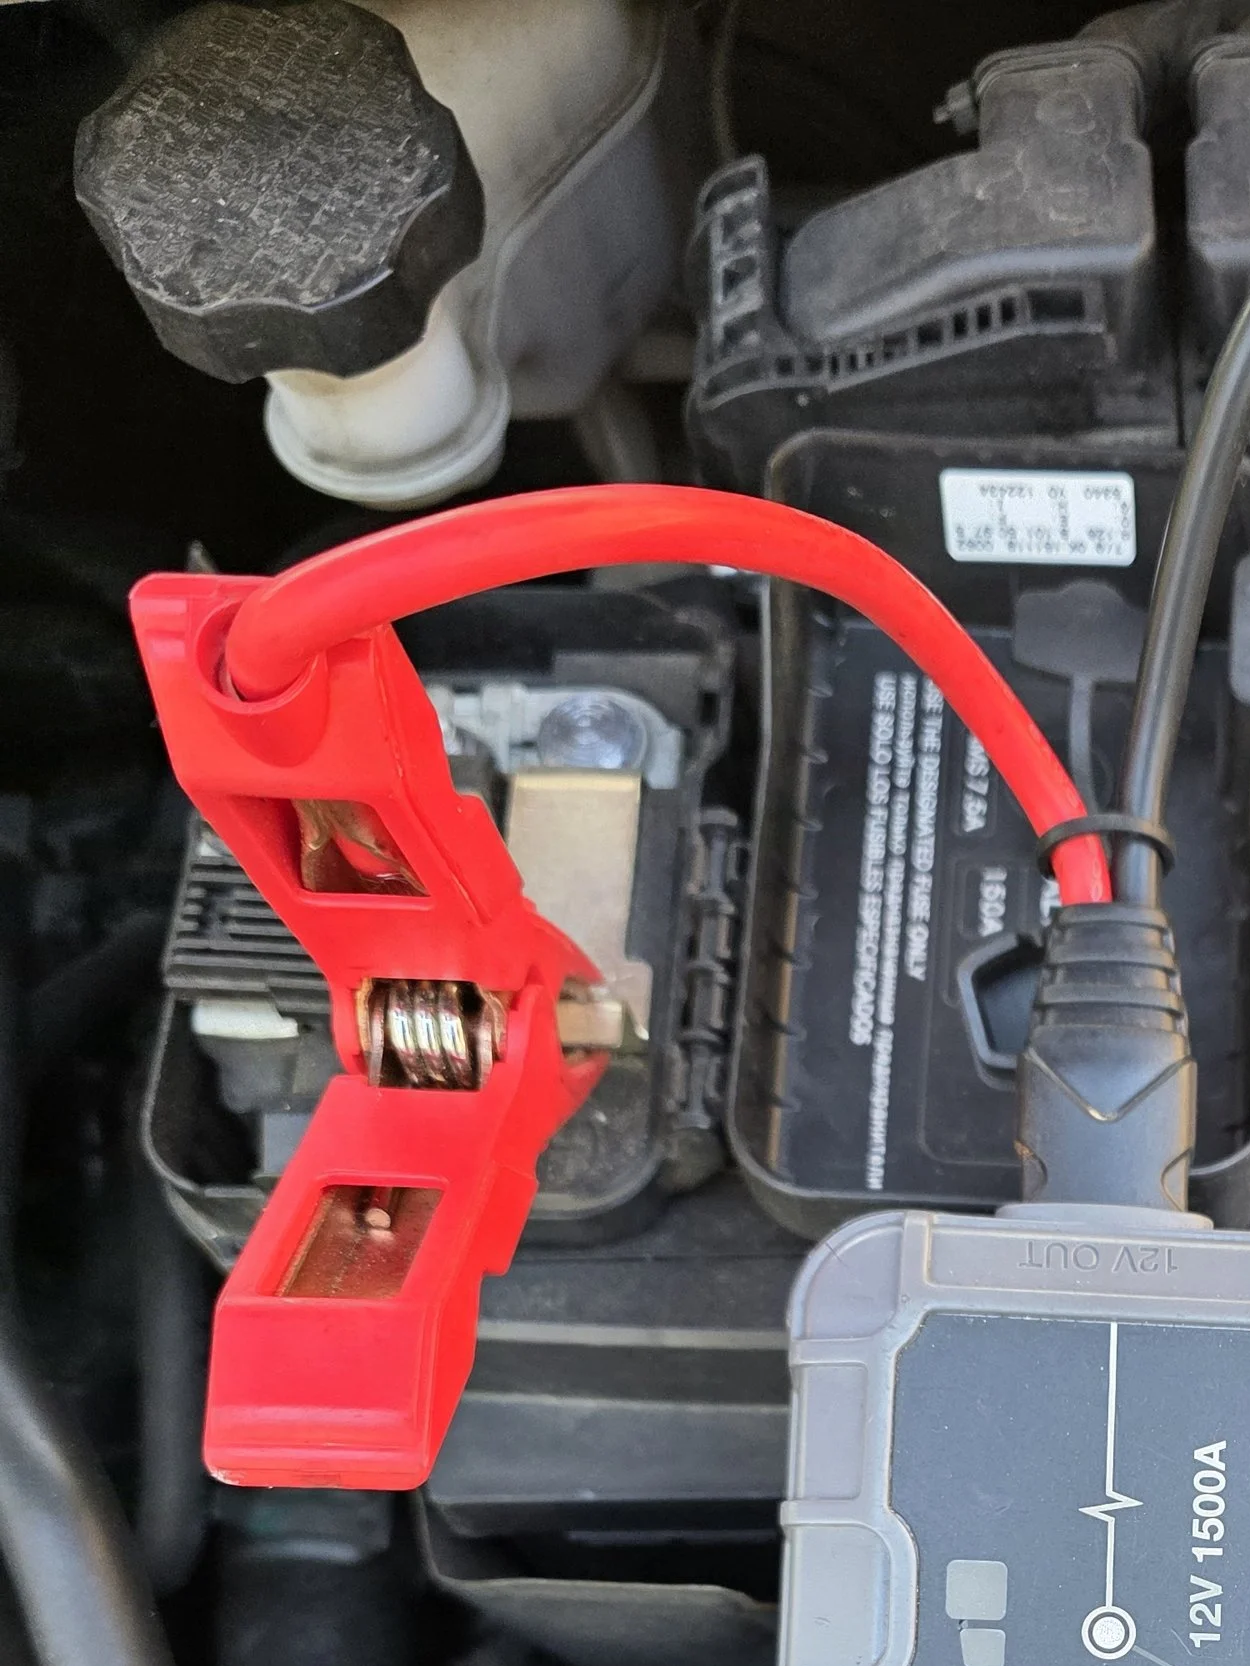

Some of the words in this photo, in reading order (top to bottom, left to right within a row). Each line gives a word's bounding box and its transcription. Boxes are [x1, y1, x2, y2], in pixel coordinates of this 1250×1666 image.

[873, 671, 897, 712] USE
[868, 711, 896, 765] SOLO
[918, 712, 944, 753] THE
[865, 764, 892, 805] LOS
[910, 753, 941, 872] DESIGNATED
[859, 805, 889, 893] FUSIBLES
[906, 870, 933, 922] FUSE
[849, 892, 883, 1046] ESPECIFICADOS
[903, 922, 930, 982] ONLY
[1017, 1241, 1099, 1271] OUT
[1112, 1245, 1179, 1274] 12V
[1191, 1440, 1227, 1563] 1500A
[1189, 1574, 1223, 1648] 12V
